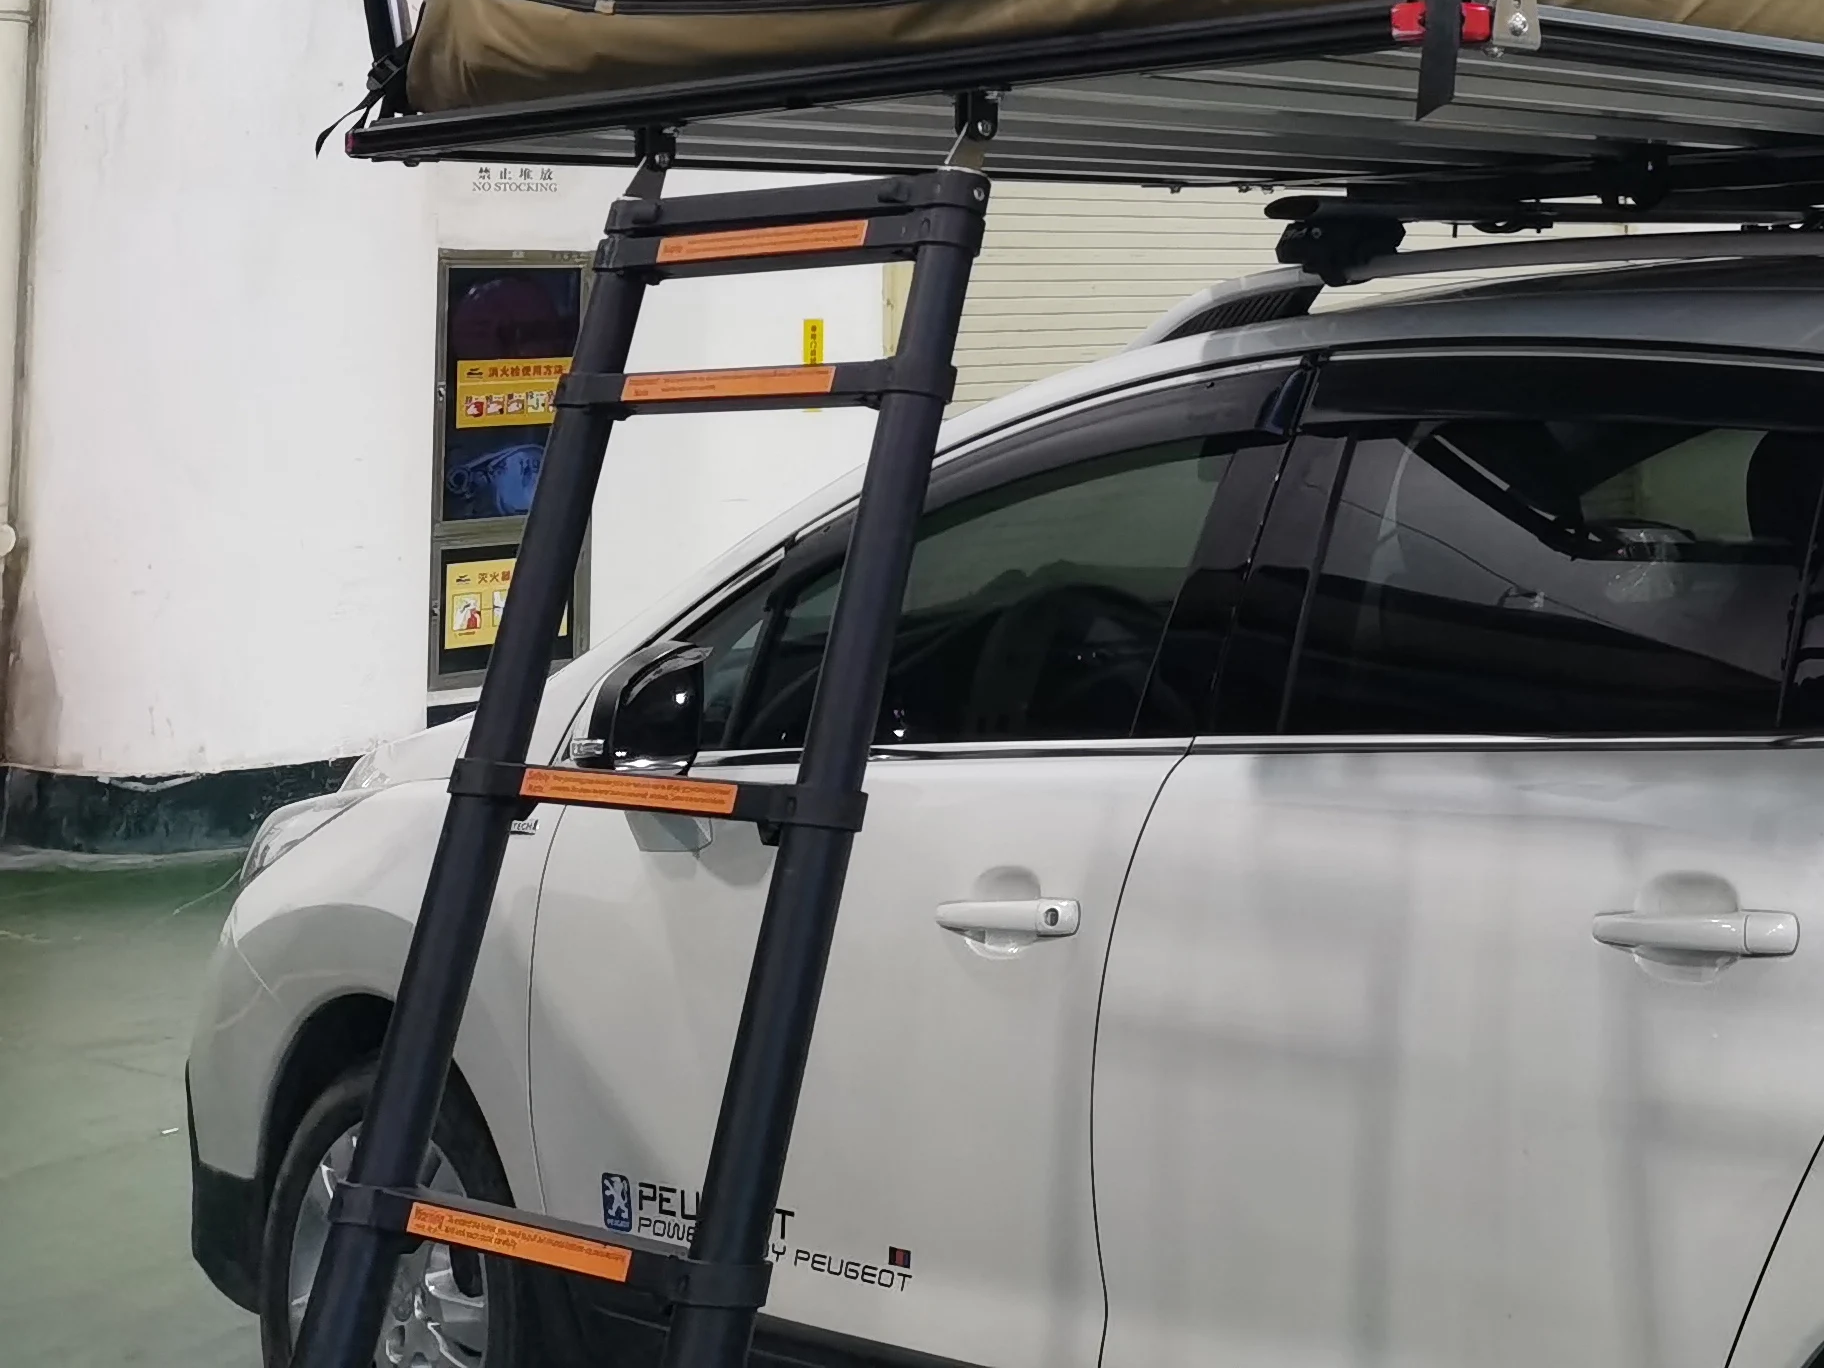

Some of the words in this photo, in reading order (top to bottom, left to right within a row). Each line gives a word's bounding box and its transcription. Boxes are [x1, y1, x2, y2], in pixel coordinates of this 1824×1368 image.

[472, 182, 491, 192] NO
[494, 182, 557, 192] STOCKING
[794, 1248, 913, 1292] PEUGEOT
